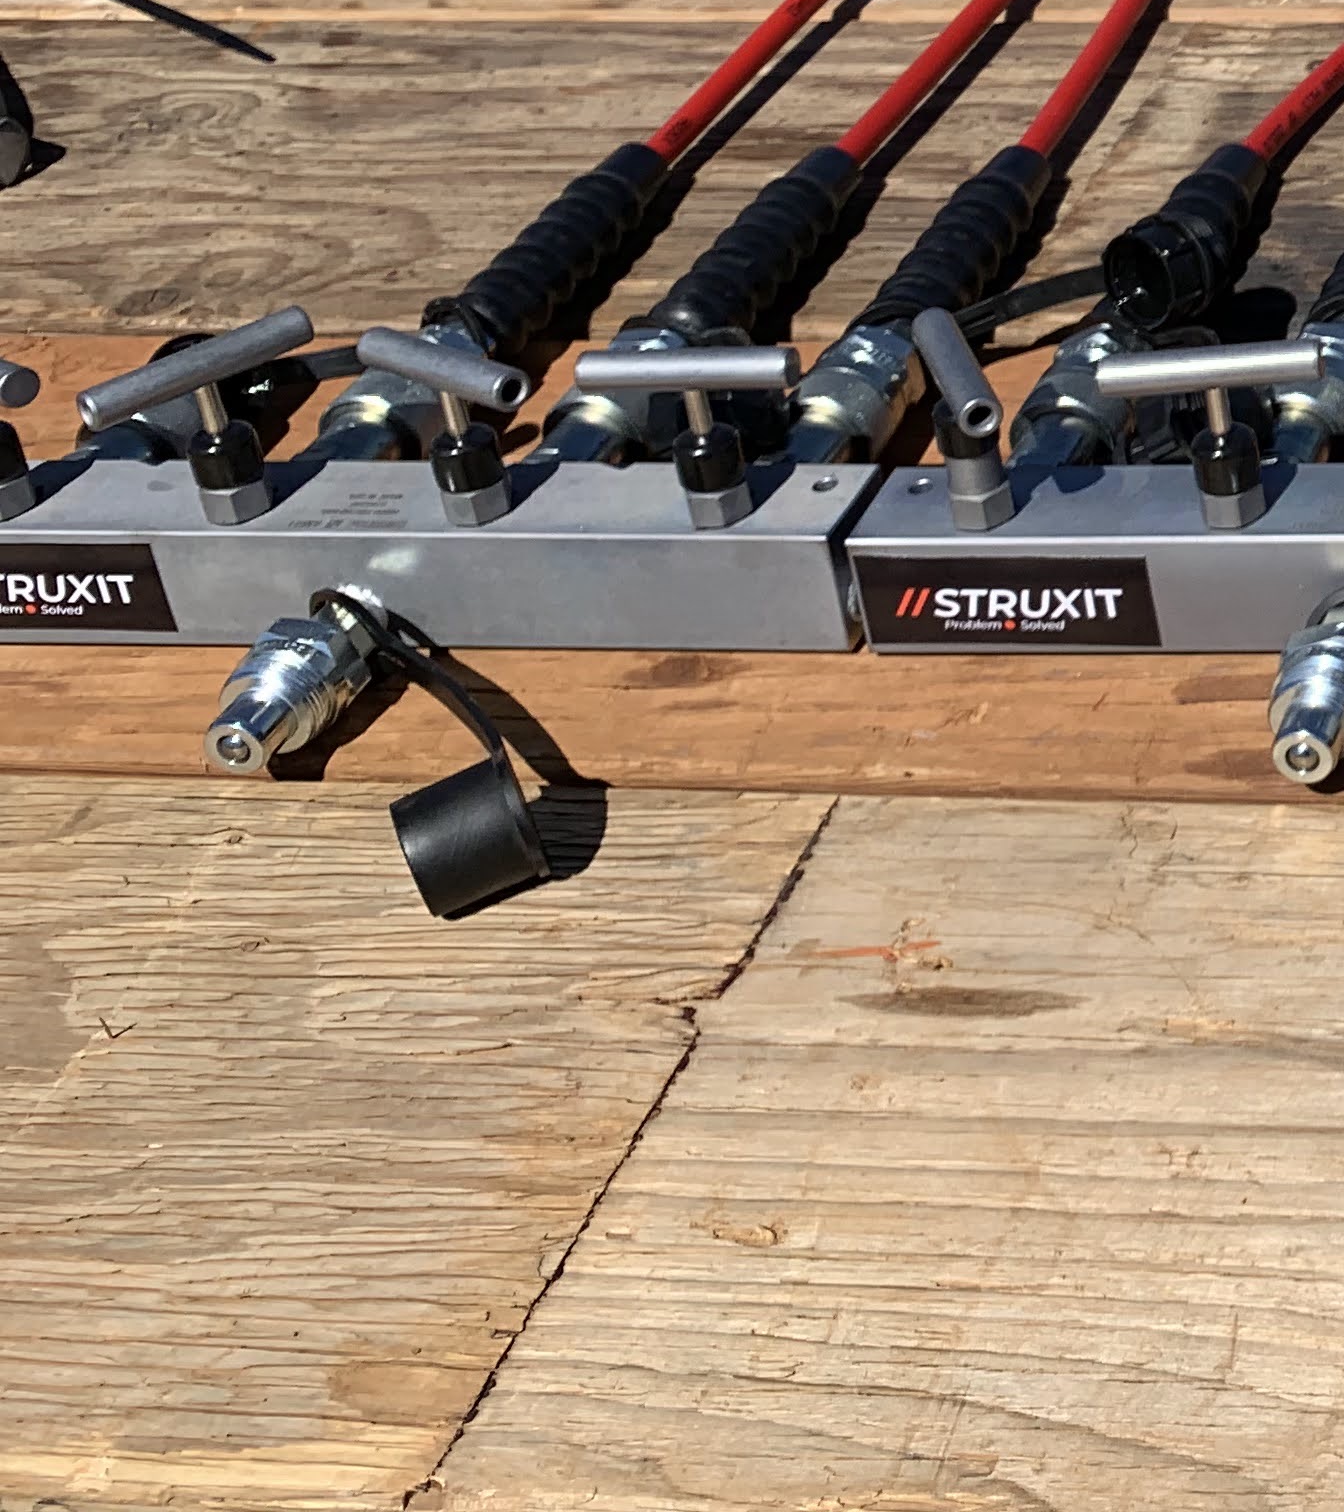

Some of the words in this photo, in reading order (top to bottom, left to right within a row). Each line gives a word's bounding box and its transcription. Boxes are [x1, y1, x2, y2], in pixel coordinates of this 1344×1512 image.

[40, 603, 84, 616] Solved
[944, 619, 1003, 630] Problem
[1020, 619, 1066, 631] Solved
